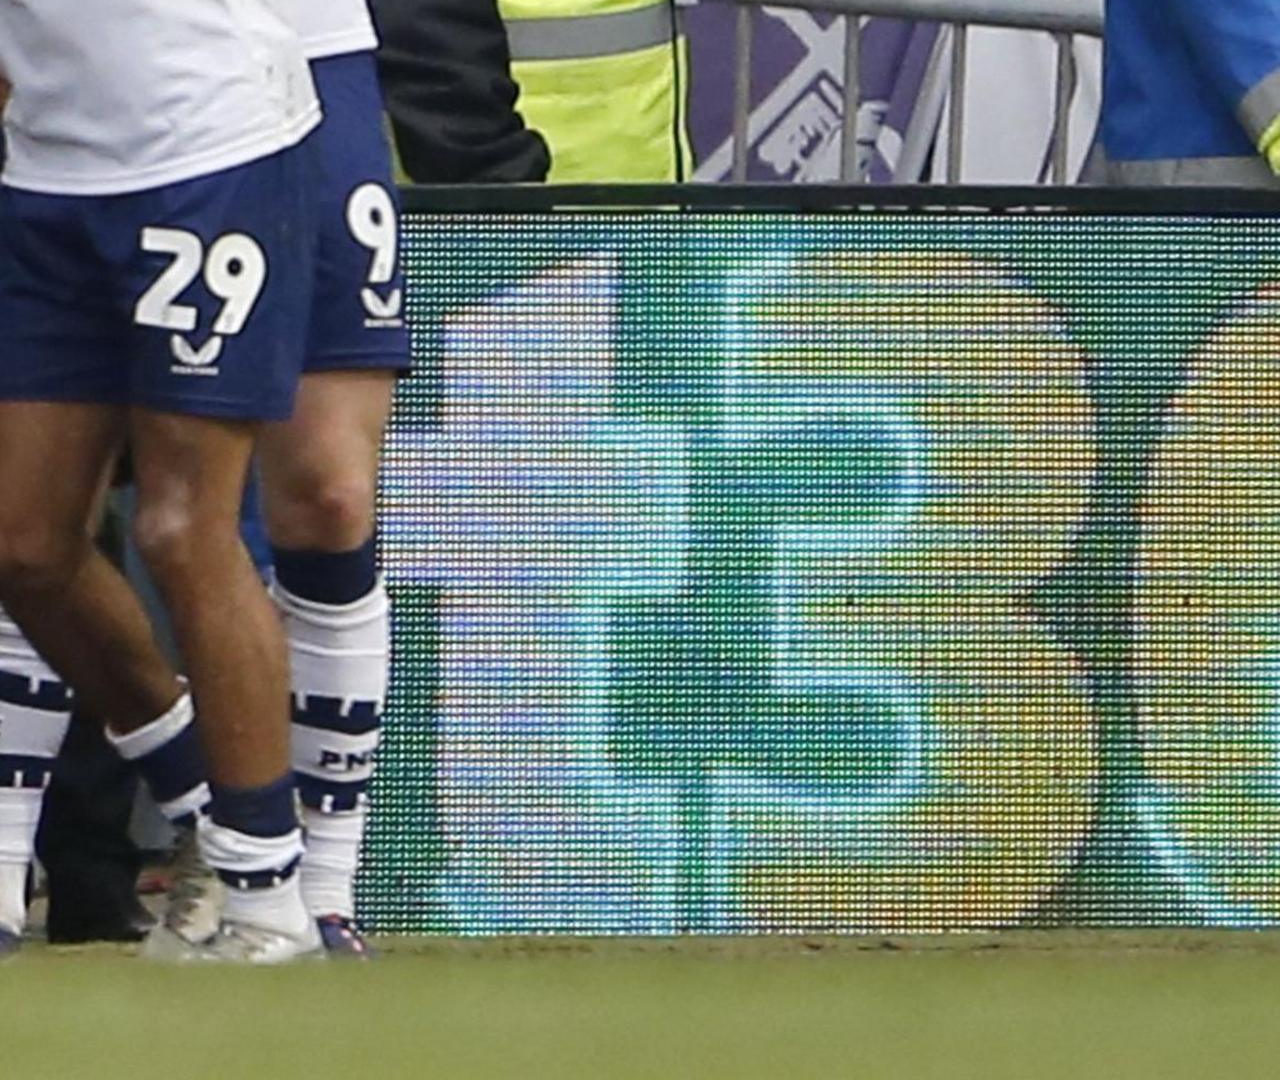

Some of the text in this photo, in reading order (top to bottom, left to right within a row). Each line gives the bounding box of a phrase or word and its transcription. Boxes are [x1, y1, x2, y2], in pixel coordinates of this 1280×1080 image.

[134, 226, 267, 335] 29
[346, 182, 397, 284] 9
[320, 749, 378, 771] PN
